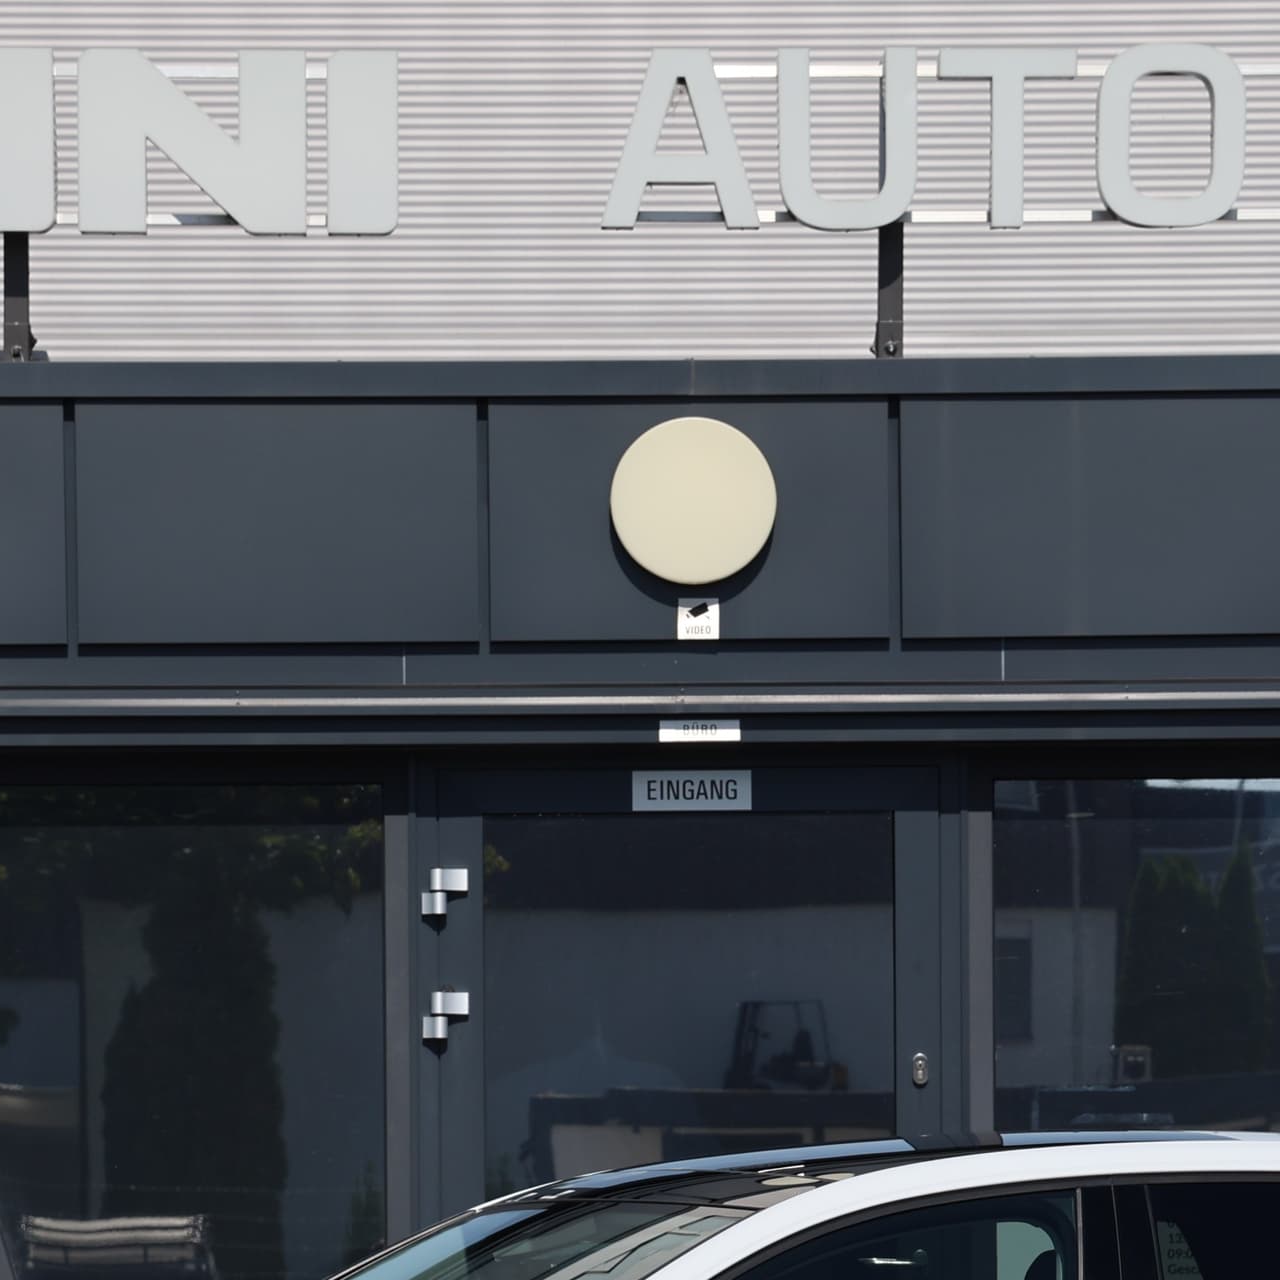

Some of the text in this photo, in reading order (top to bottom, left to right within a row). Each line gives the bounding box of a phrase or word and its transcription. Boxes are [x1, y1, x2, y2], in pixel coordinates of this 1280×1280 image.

[601, 41, 1245, 232] AUTO
[685, 625, 712, 635] VIDEO
[682, 721, 718, 736] BÜRO
[647, 779, 739, 801] EINGANG
